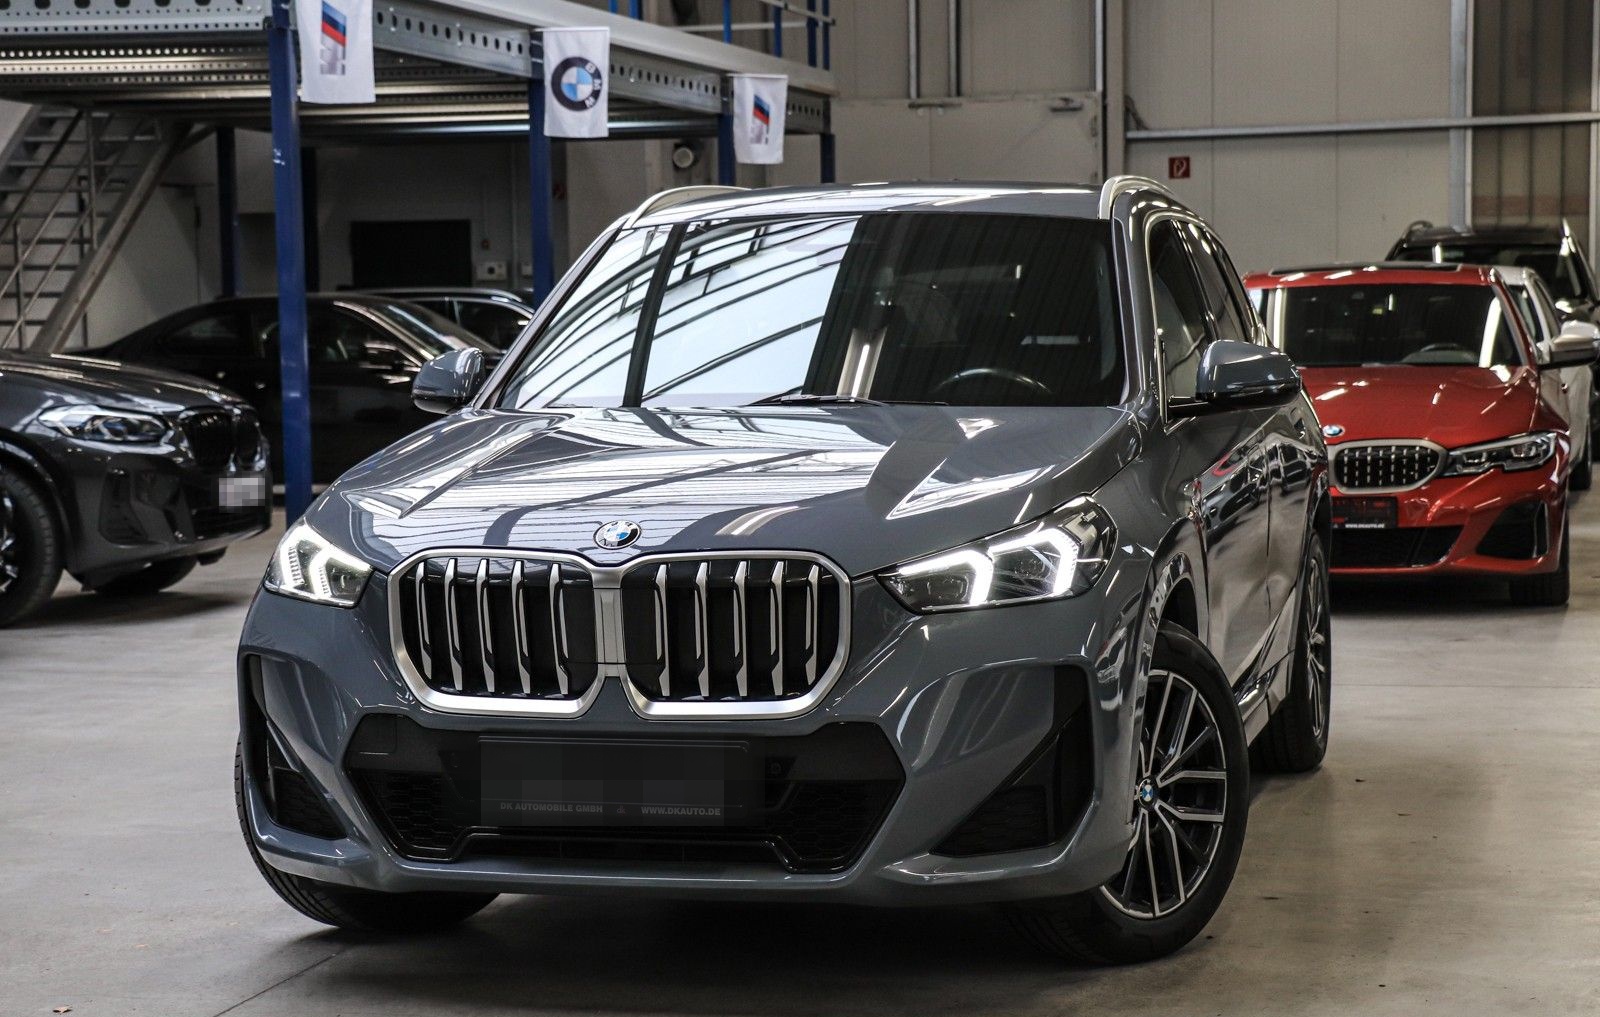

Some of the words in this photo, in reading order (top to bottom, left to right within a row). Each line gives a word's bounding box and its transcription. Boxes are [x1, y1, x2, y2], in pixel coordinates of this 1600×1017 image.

[500, 802, 513, 810] DK
[515, 803, 573, 812] AUTOMOBILE
[575, 804, 603, 813] GMBH
[641, 806, 721, 816] WWW.DKAUTO.DE
